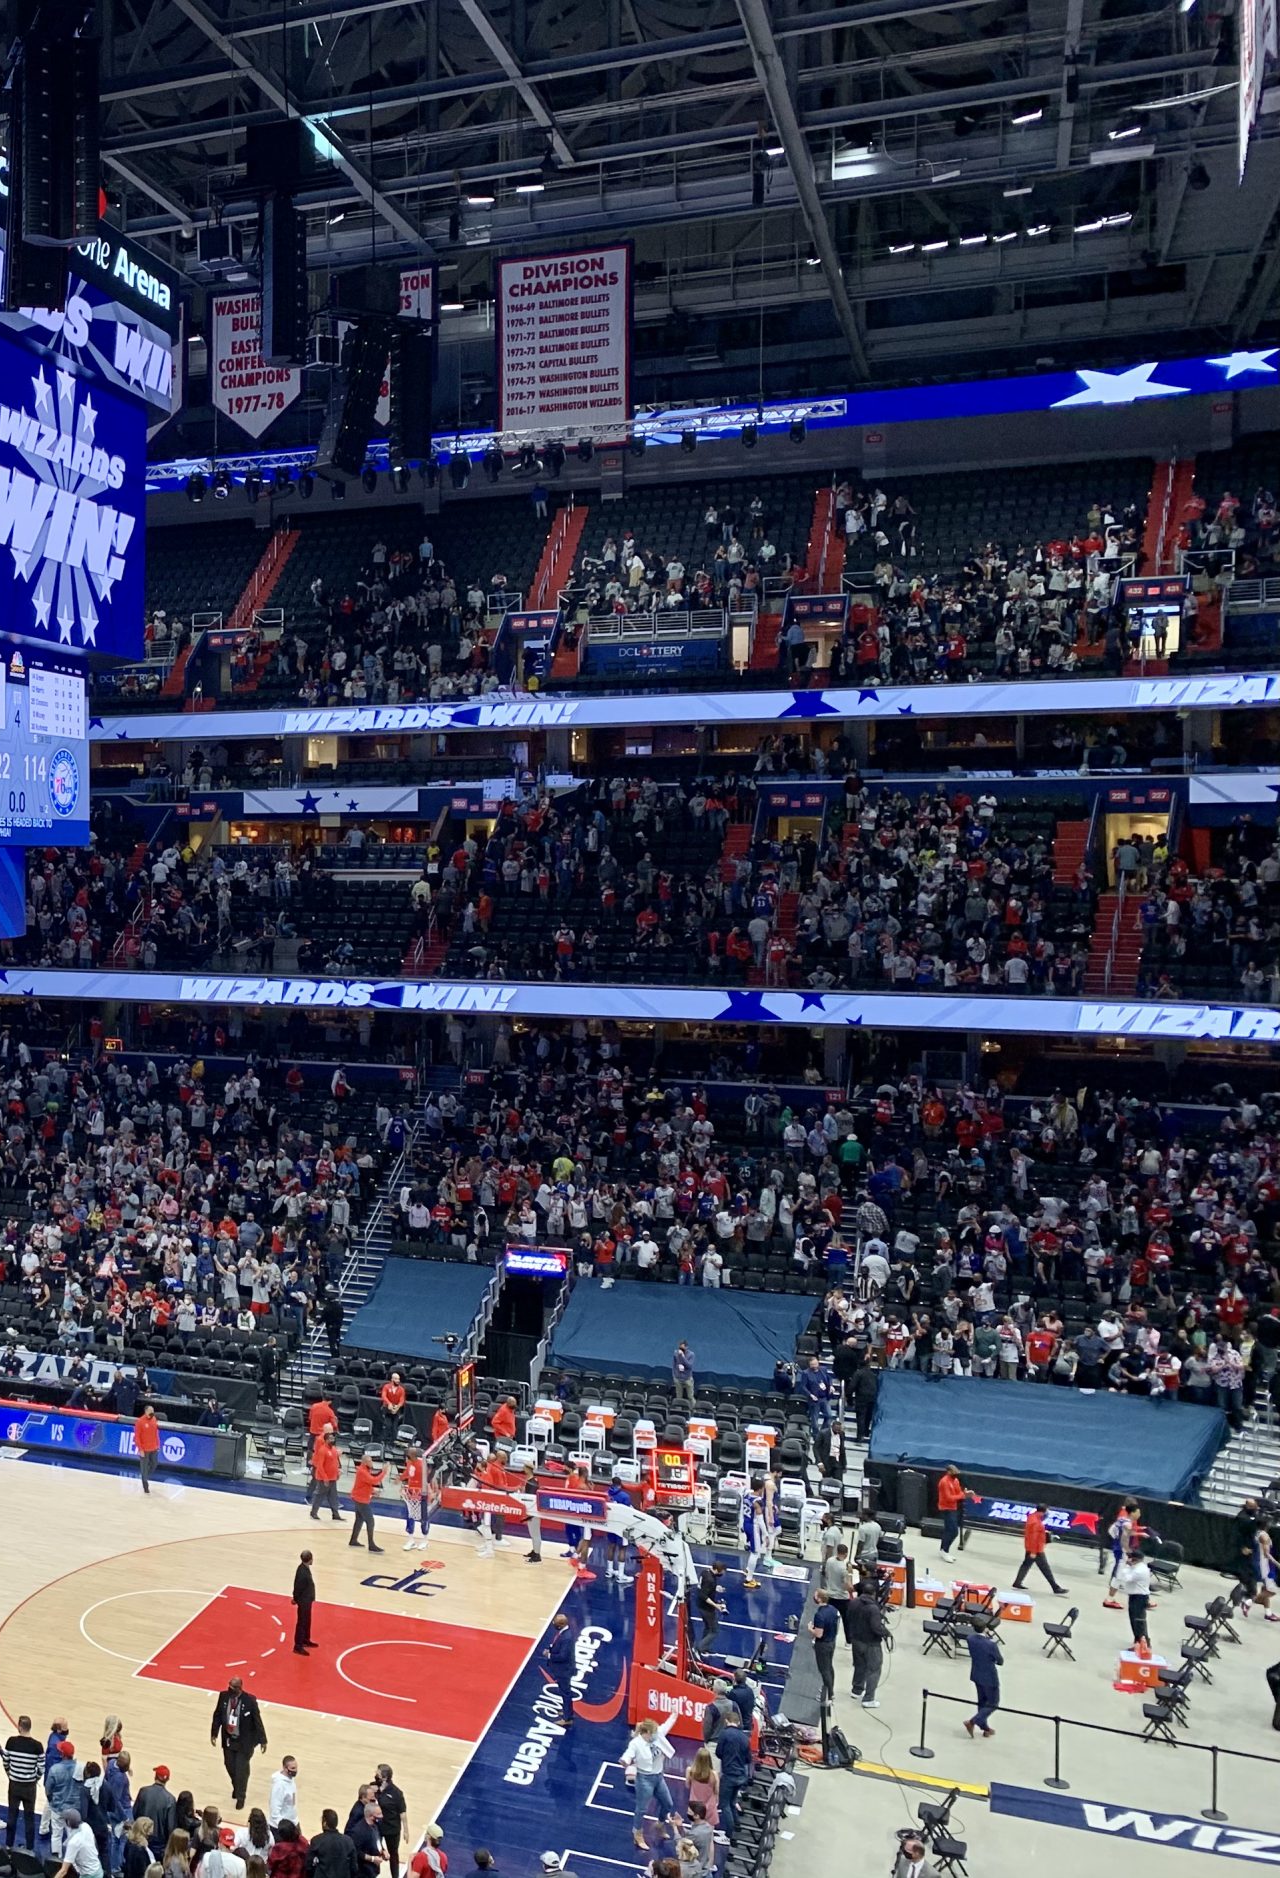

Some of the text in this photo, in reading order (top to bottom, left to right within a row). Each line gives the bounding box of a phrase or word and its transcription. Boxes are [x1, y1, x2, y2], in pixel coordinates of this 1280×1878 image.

[114, 245, 171, 311] Arena
[523, 257, 604, 280] DIVISION
[509, 272, 619, 297] CHAMPIONS
[506, 293, 610, 313] 1968-69 BALTIMORE BULLETS
[506, 308, 610, 328] 1970-71 BALTIMORE BULLETS
[506, 323, 610, 343] 1971-72 BALTIMORE BULLETS
[506, 338, 610, 358] 1972-73 BALTIMORE BULLETS
[506, 354, 598, 372] 1973-74 CAPITAL BULLETS
[220, 368, 291, 390] CHAMPIONS
[506, 367, 619, 387] 1974-75 WASHINGTON BULLETS
[506, 382, 619, 402] 1978-79 WASHINGTON BULLETS
[227, 392, 285, 414] 1977-78
[506, 397, 622, 416] 2016-17 WASHINGTON WIZARDS
[14, 709, 21, 728] 4
[282, 702, 579, 732] WIZARDS WIN!
[24, 754, 47, 782] 114
[9, 790, 26, 813] 0.0
[1151, 791, 1166, 800] 227
[32, 818, 46, 828] BACK
[179, 976, 518, 1012] WIZARDS WIN!
[50, 1423, 187, 1457] VS TNT
[646, 1572, 657, 1627] NBA TV
[923, 1591, 933, 1602] G
[1010, 1604, 1021, 1616] G
[1138, 1666, 1150, 1678] G
[659, 1692, 693, 1715] that's
[503, 1716, 567, 1786] Arena
